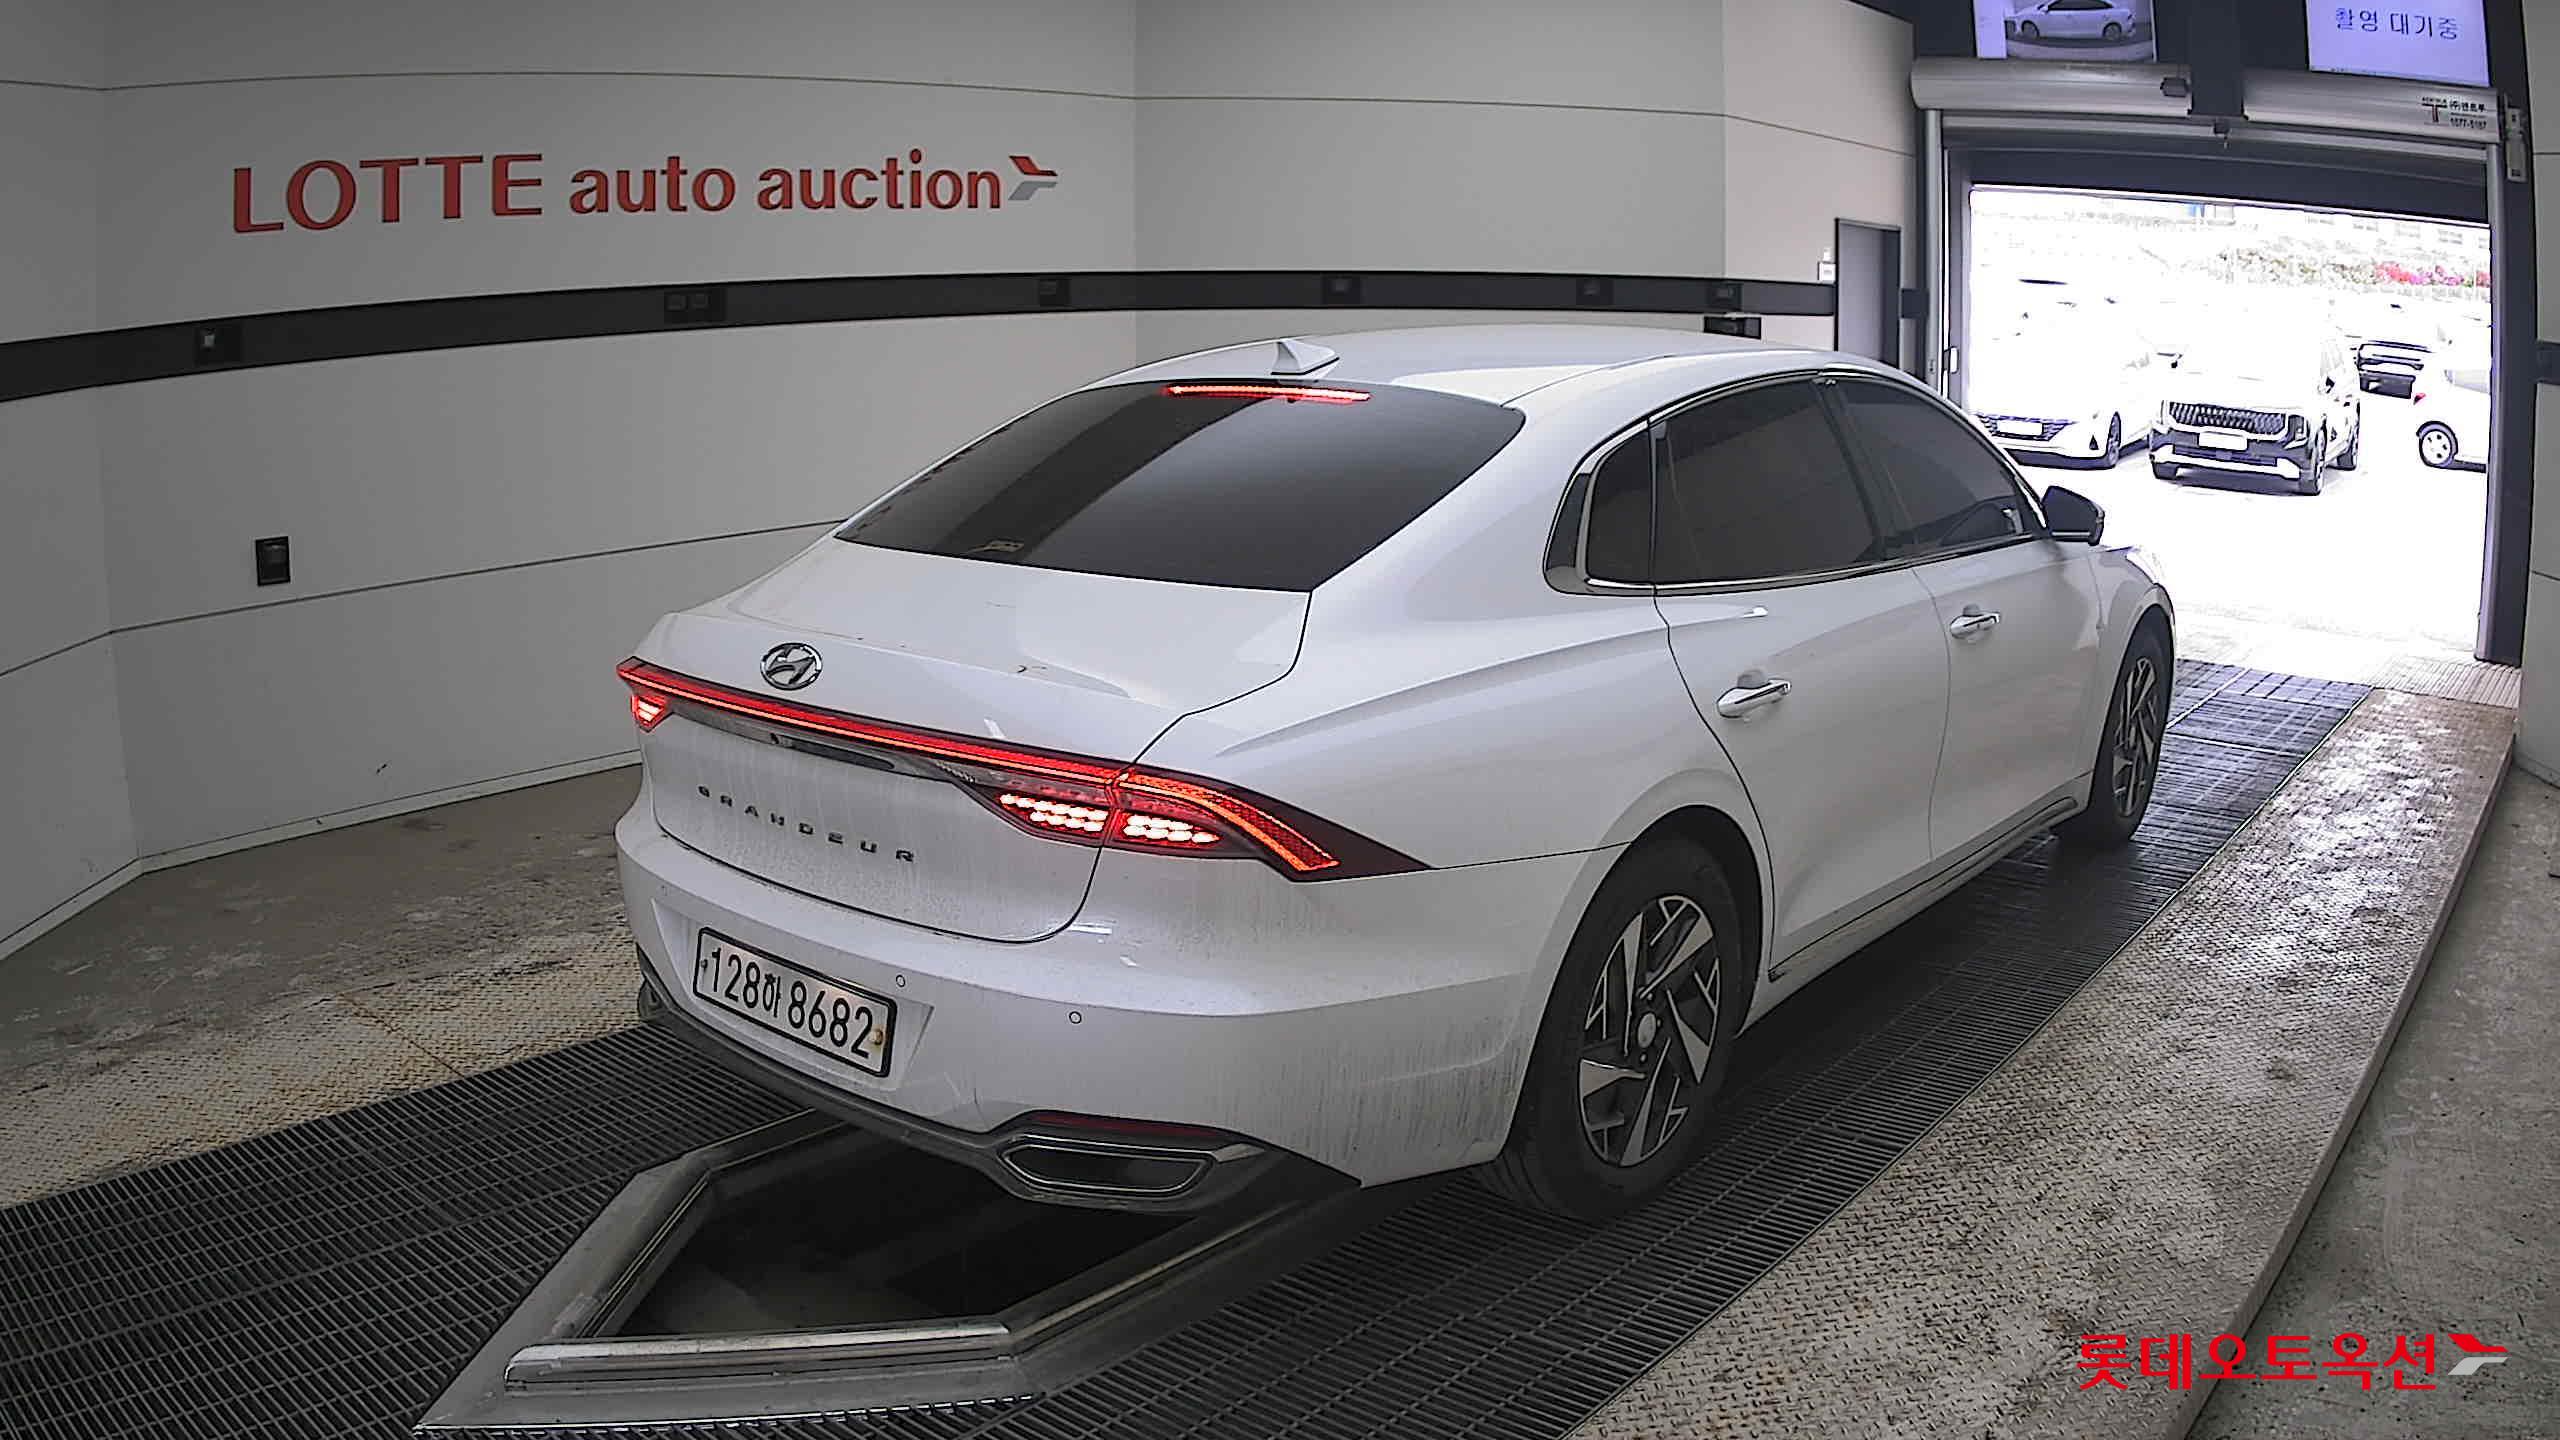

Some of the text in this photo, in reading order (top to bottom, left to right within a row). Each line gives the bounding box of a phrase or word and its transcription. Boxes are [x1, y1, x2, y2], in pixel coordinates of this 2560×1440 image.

[2336, 8, 2458, 40] 촬영 대기중
[233, 148, 1003, 233] LOTTE auto auction
[698, 785, 914, 863] GRANDEUR
[711, 947, 873, 1059] 128하8682
